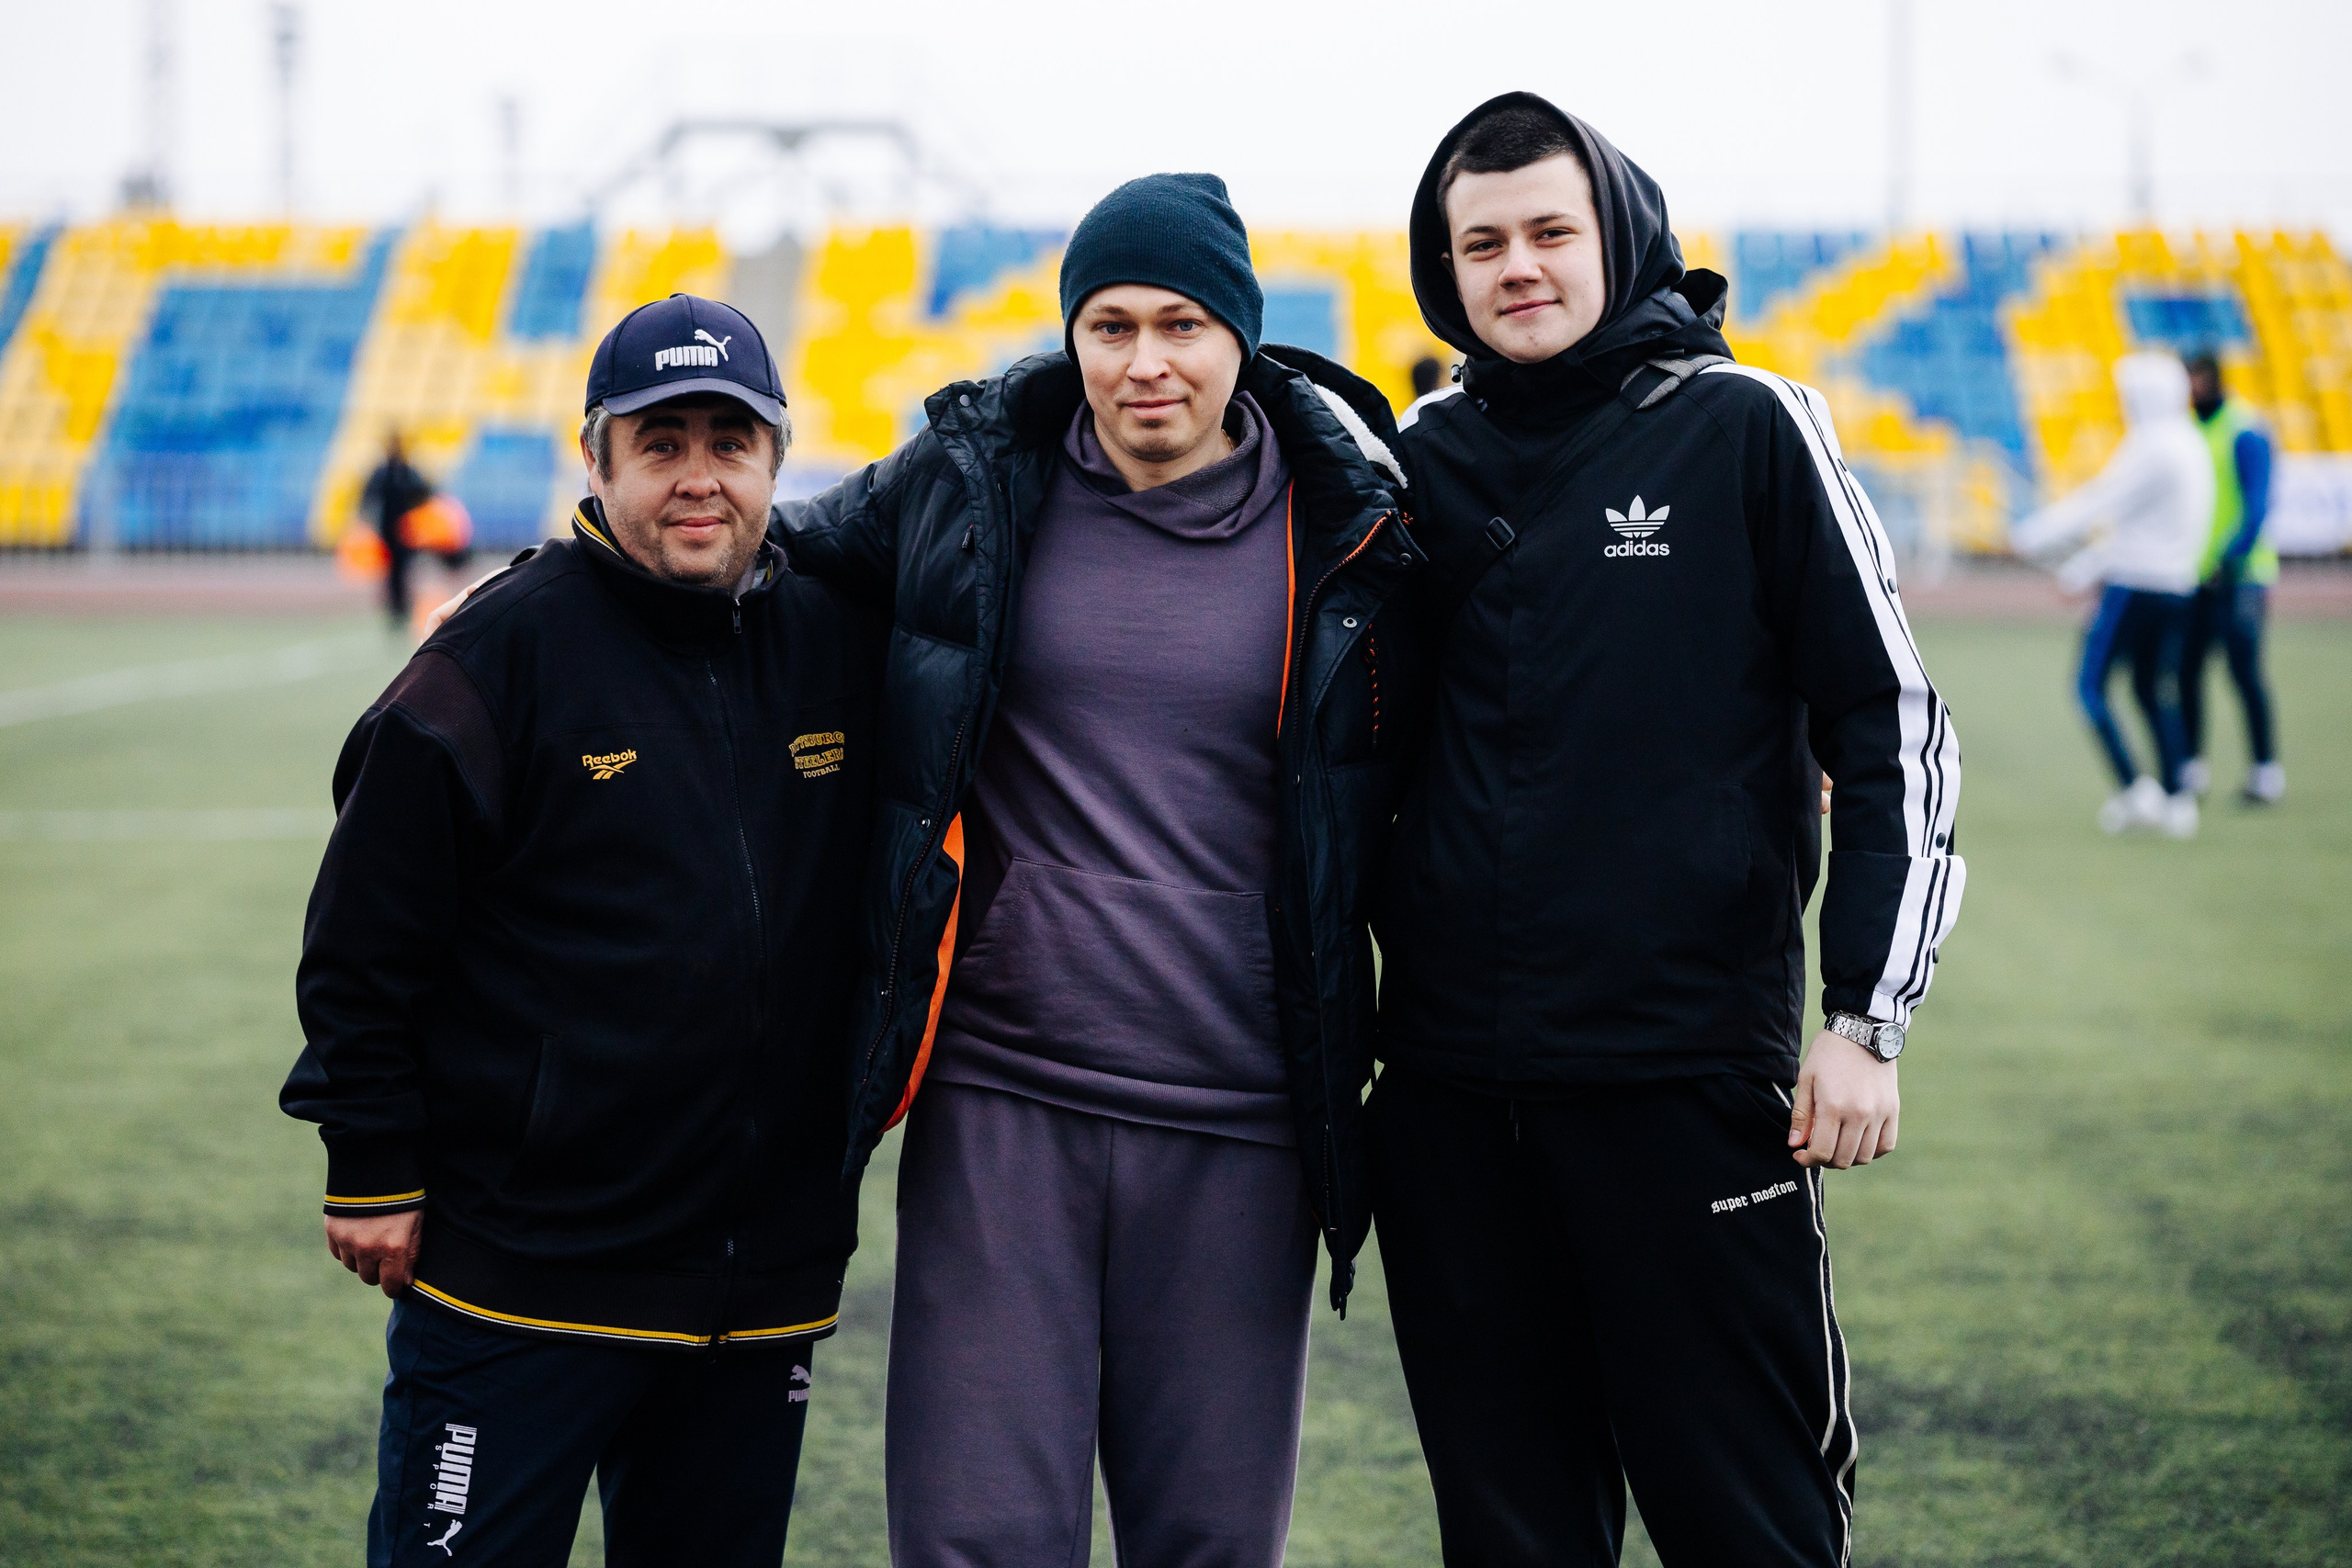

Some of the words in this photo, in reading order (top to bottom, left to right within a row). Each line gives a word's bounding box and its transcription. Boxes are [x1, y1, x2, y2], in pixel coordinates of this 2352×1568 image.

[655, 345, 718, 371] PUMA
[1603, 540, 1670, 558] adidas
[582, 749, 637, 768] Reebok
[802, 763, 841, 779] FOOTBALL
[1711, 1195, 1748, 1213] super
[1750, 1180, 1798, 1203] mostom
[434, 1423, 478, 1515] PUMA
[423, 1445, 443, 1529] SPORT
